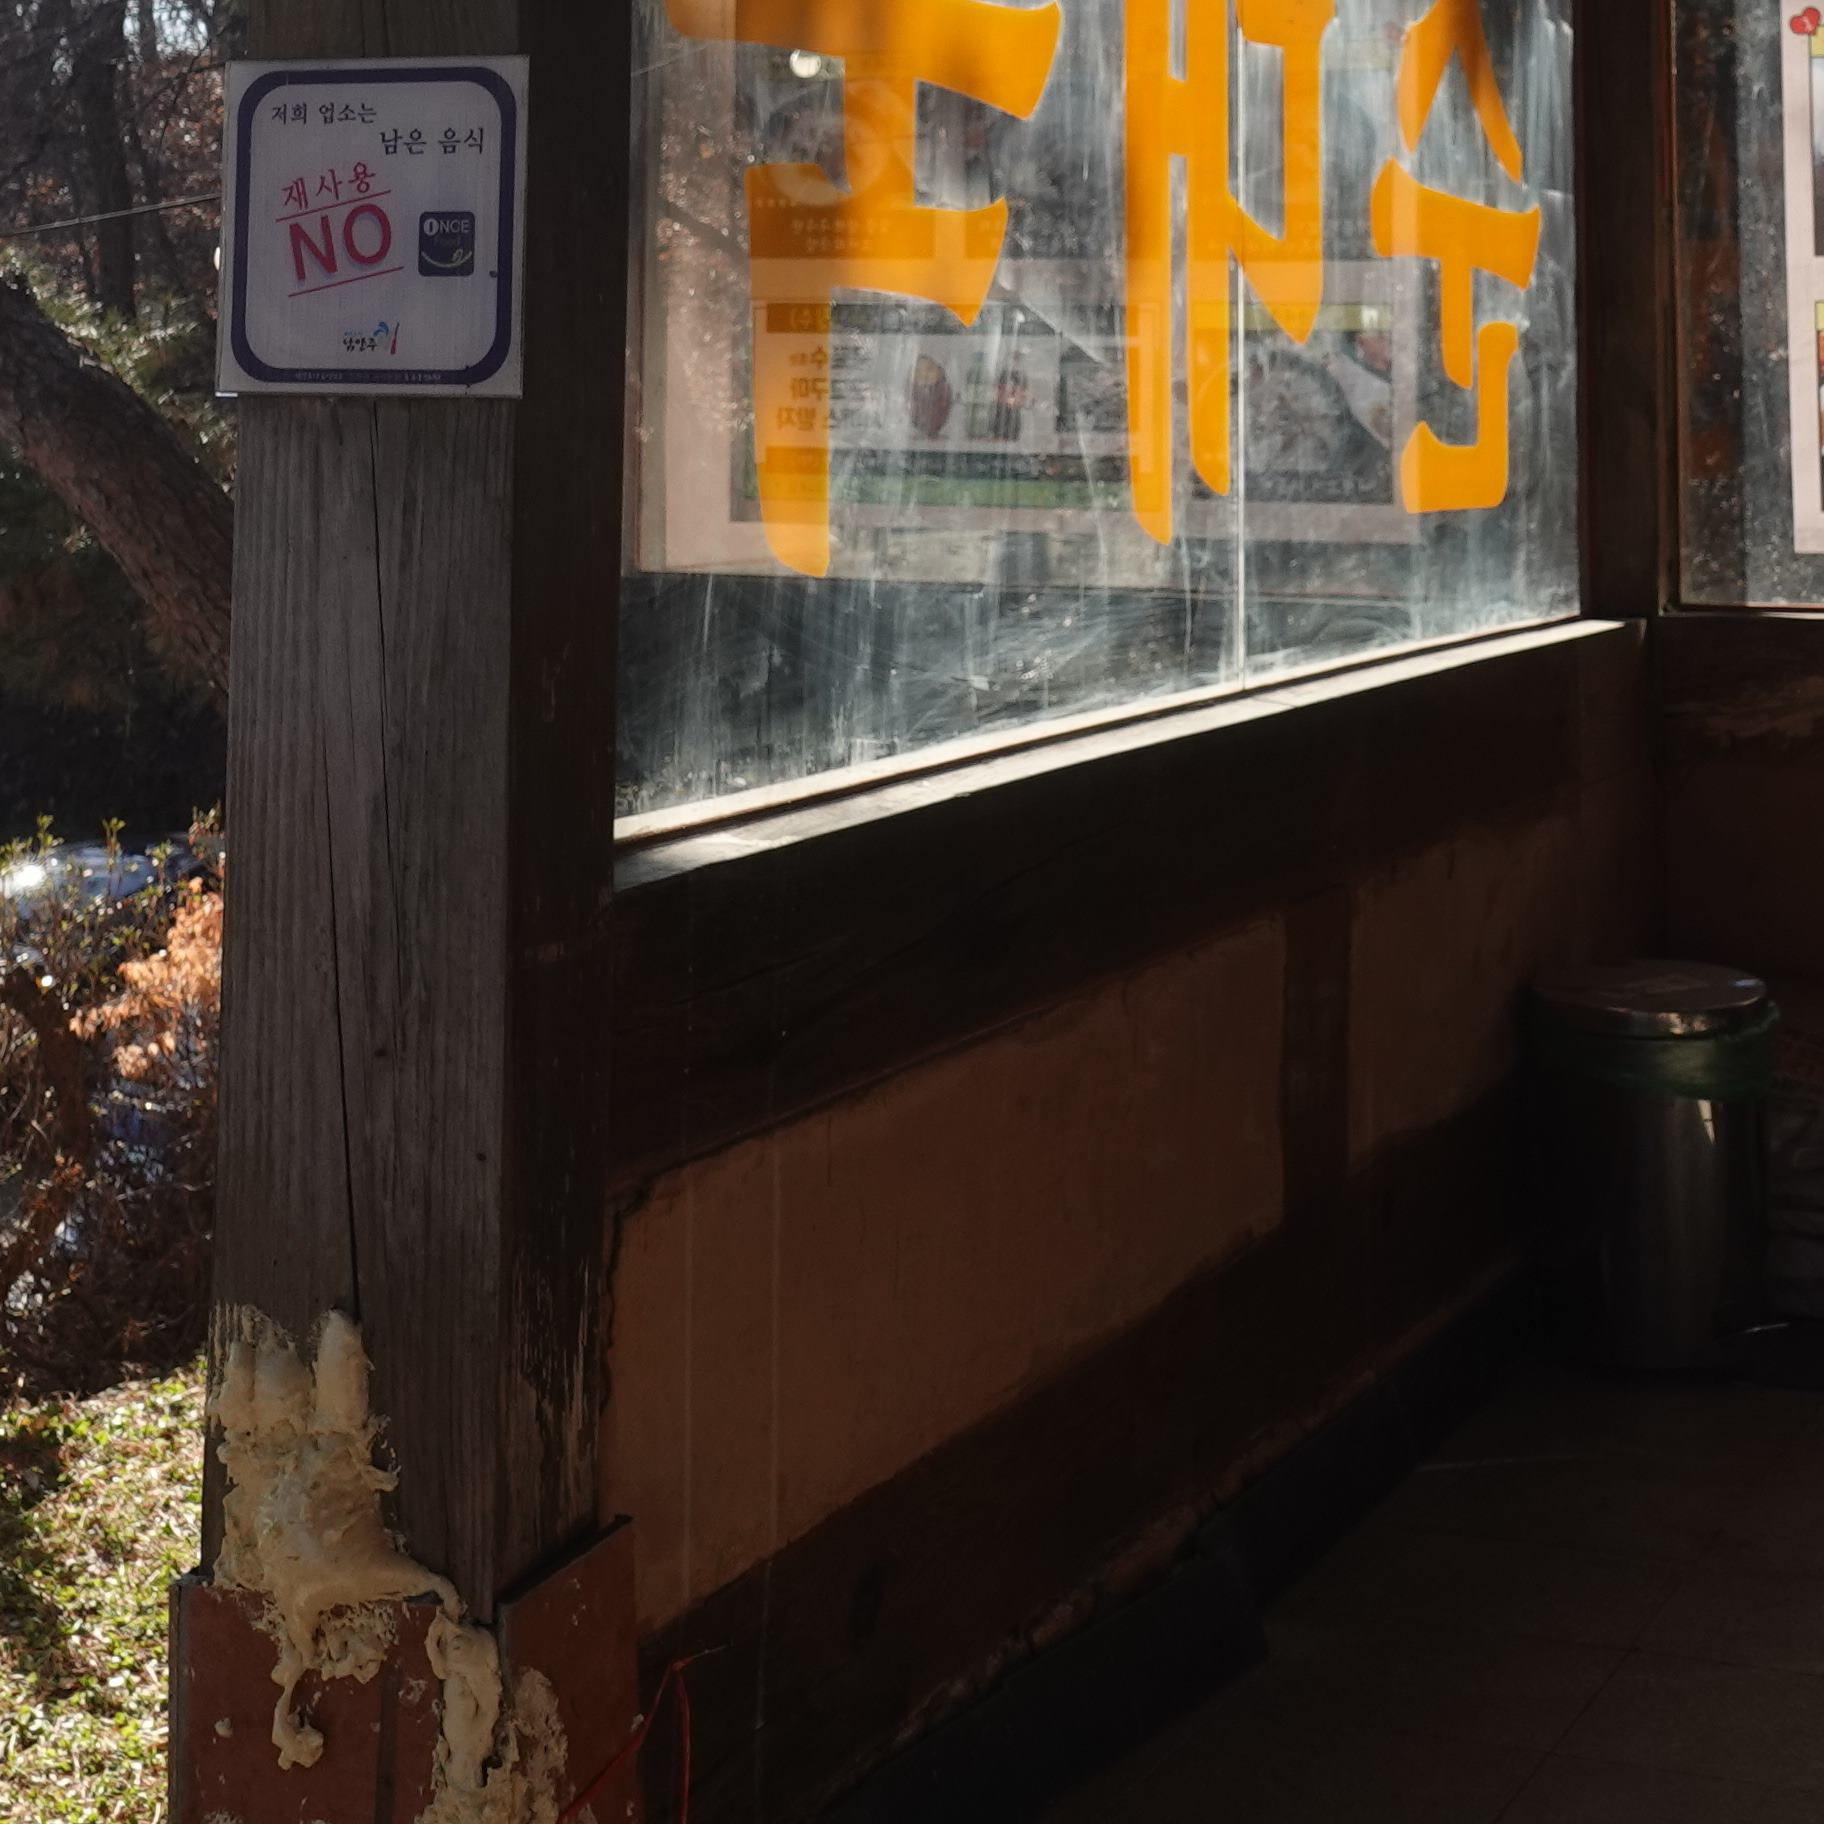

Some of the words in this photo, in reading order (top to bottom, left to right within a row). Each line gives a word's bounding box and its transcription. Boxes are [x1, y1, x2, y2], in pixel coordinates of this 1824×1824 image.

[271, 103, 309, 125] 저희
[318, 102, 378, 125] 업소는
[379, 128, 427, 156] 남은
[437, 127, 485, 155] 음식
[288, 203, 392, 281] NO
